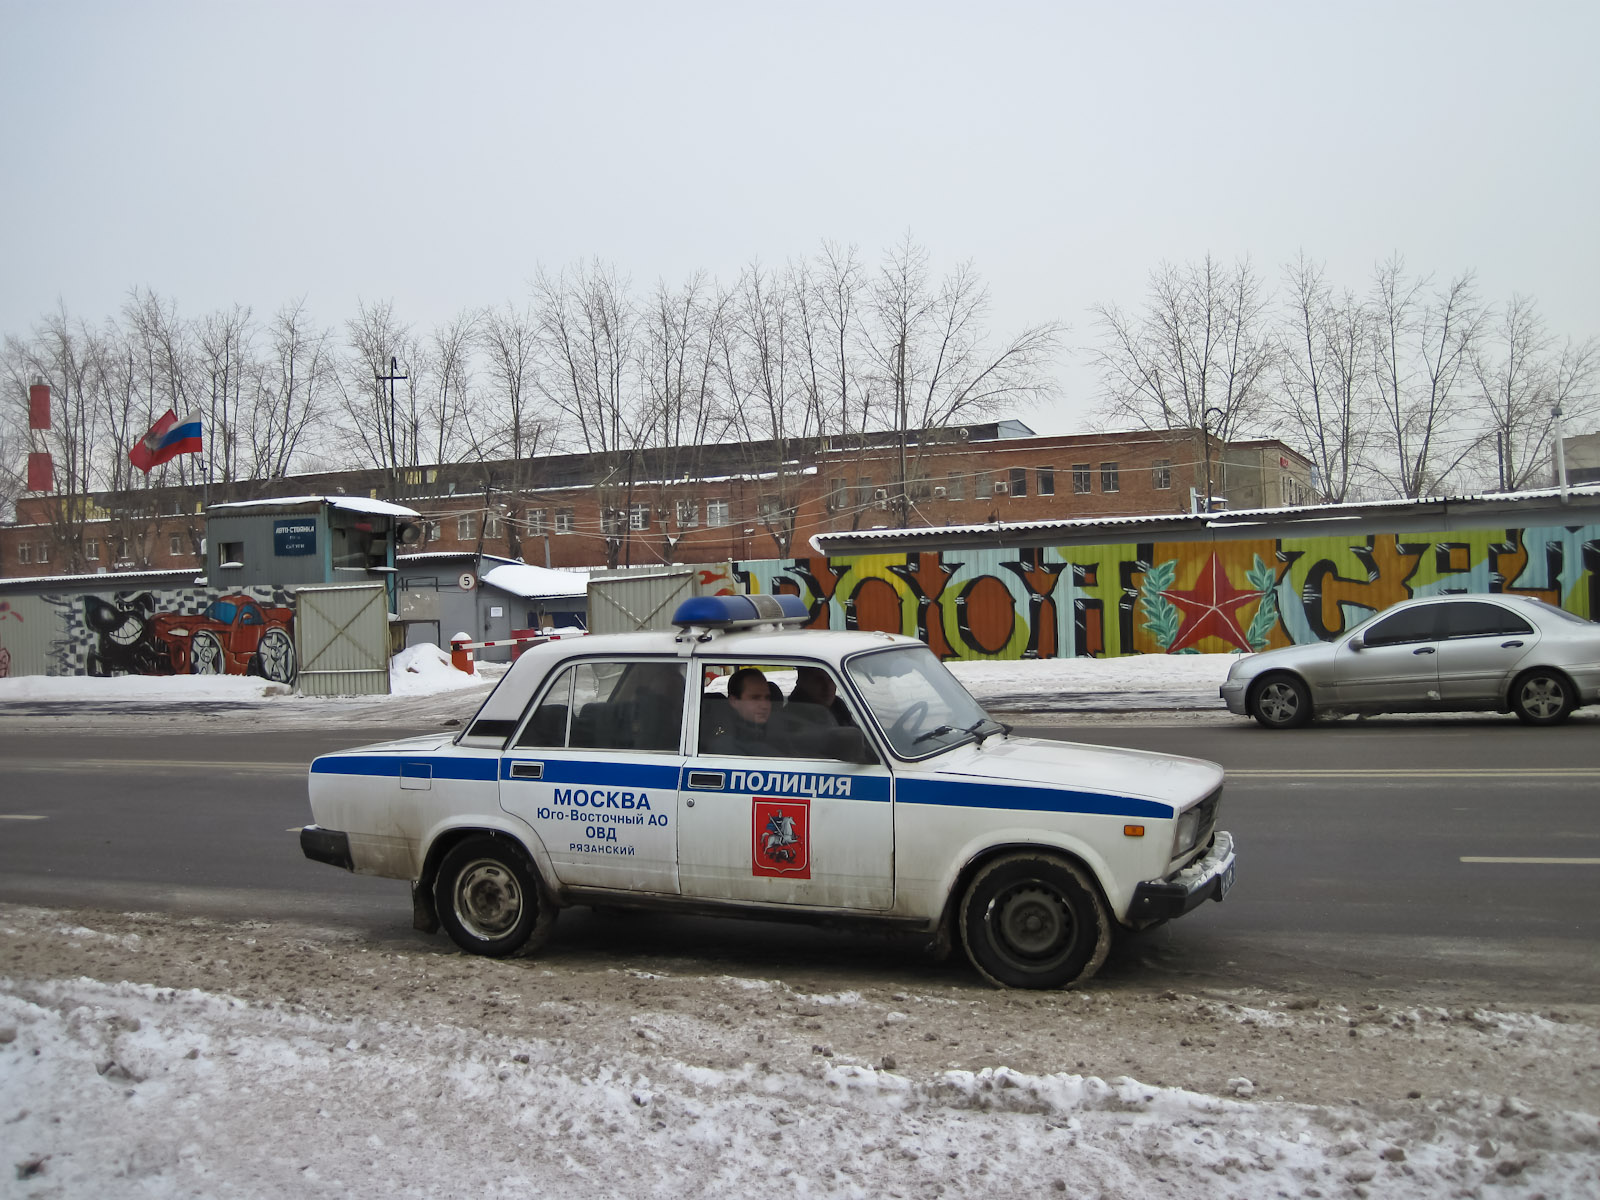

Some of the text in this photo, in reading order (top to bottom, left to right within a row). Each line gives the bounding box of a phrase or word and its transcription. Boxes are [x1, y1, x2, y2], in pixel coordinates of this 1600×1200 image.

[463, 576, 470, 586] 5
[730, 771, 852, 798] ПОЛИЦИЯ
[553, 788, 651, 810] МОСКВА
[537, 807, 668, 827] Юго-Восточный АО
[586, 826, 617, 842] ОВД
[569, 843, 635, 856] РЯЗАНСКИЙ
